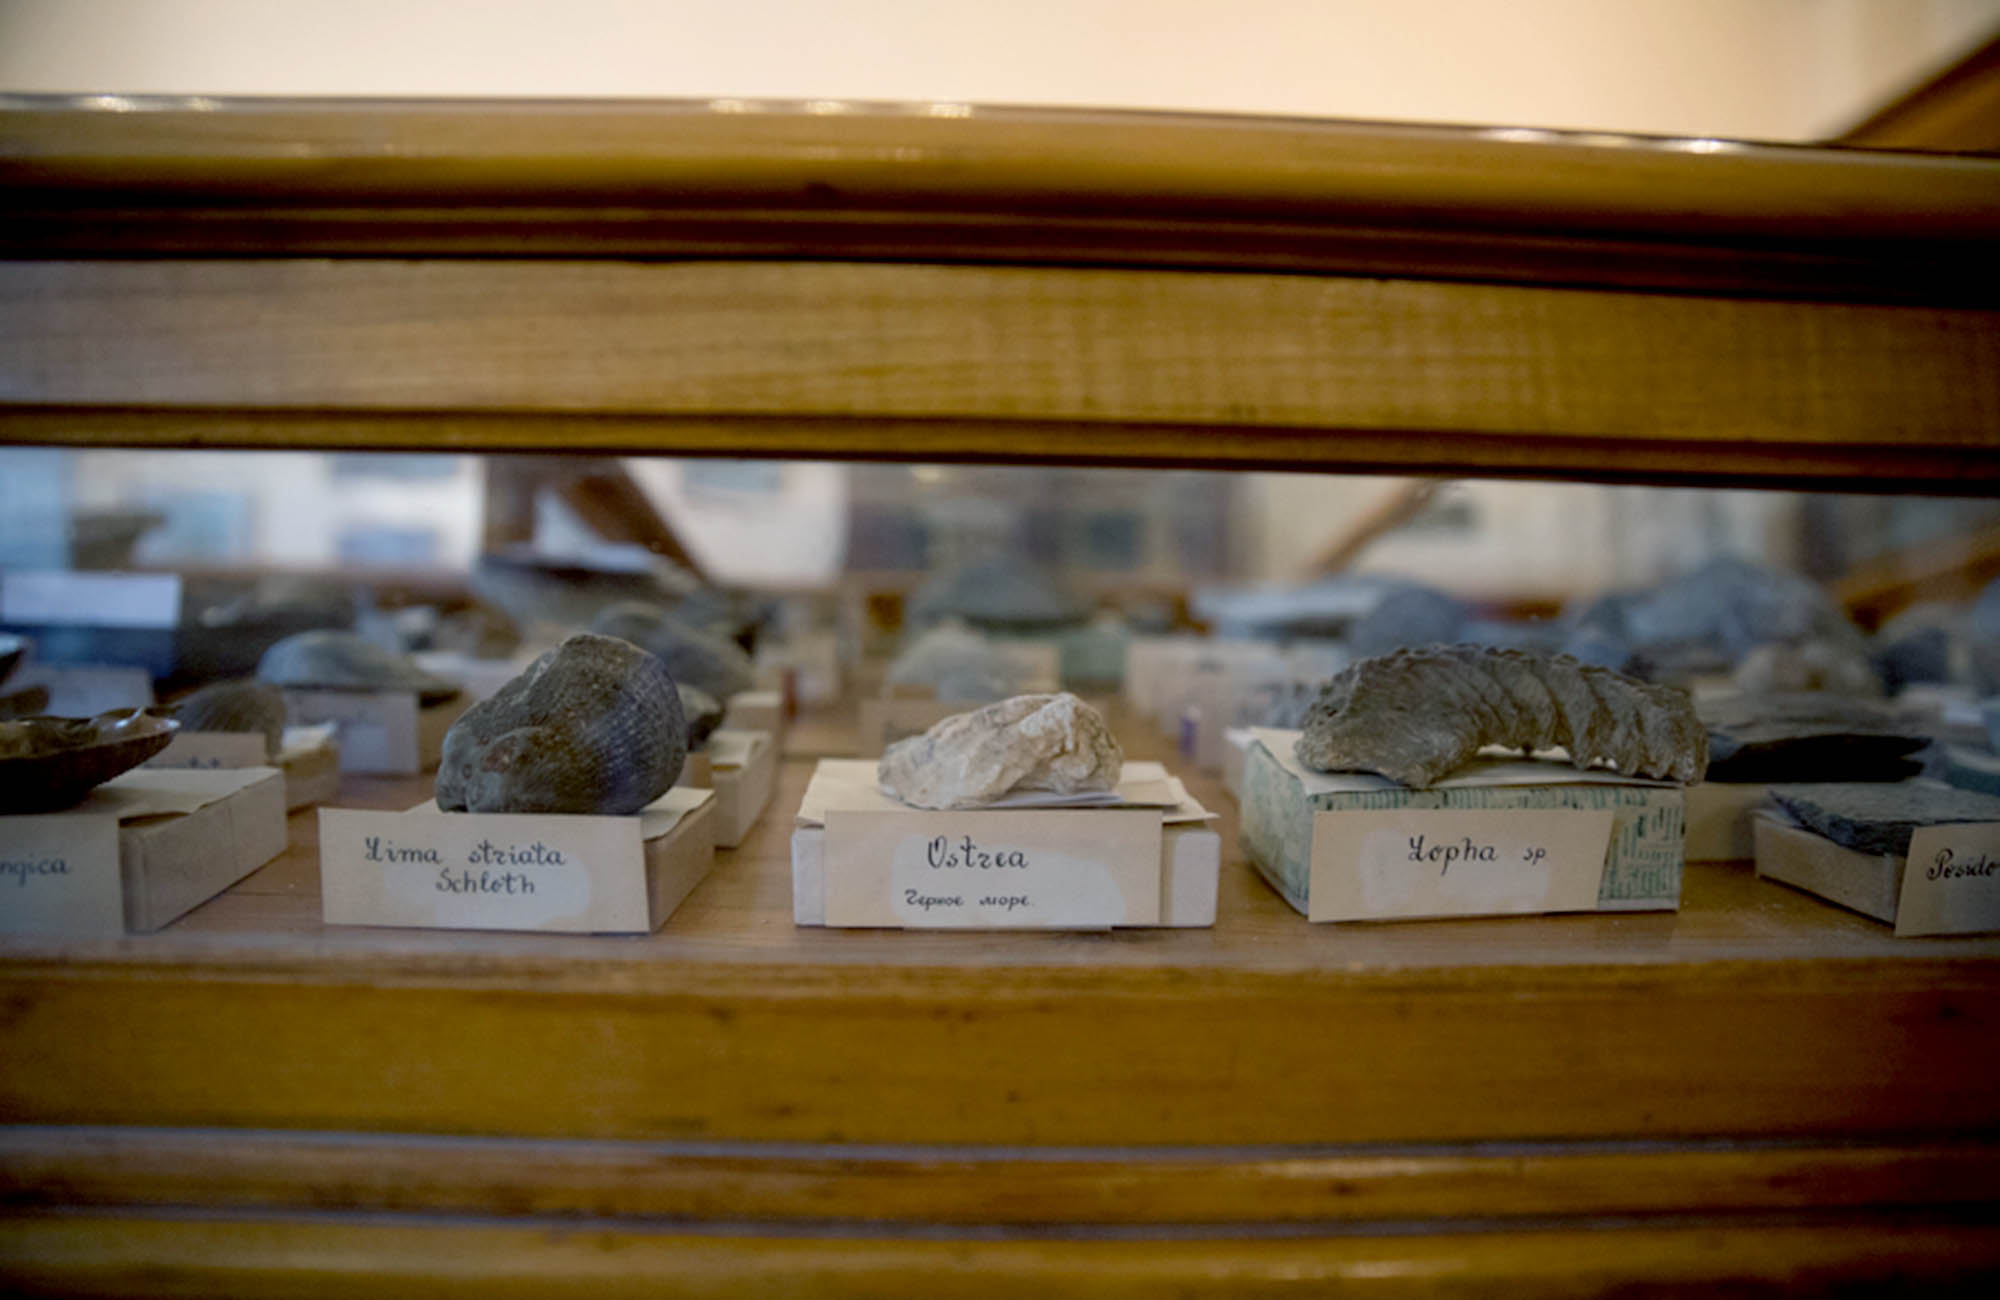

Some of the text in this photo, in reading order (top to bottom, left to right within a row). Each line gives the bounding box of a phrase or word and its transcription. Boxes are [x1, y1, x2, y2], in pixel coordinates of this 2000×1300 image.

[365, 836, 566, 866] Lima striata
[927, 834, 1029, 869] Ostrea
[1408, 834, 1498, 877] Lopha
